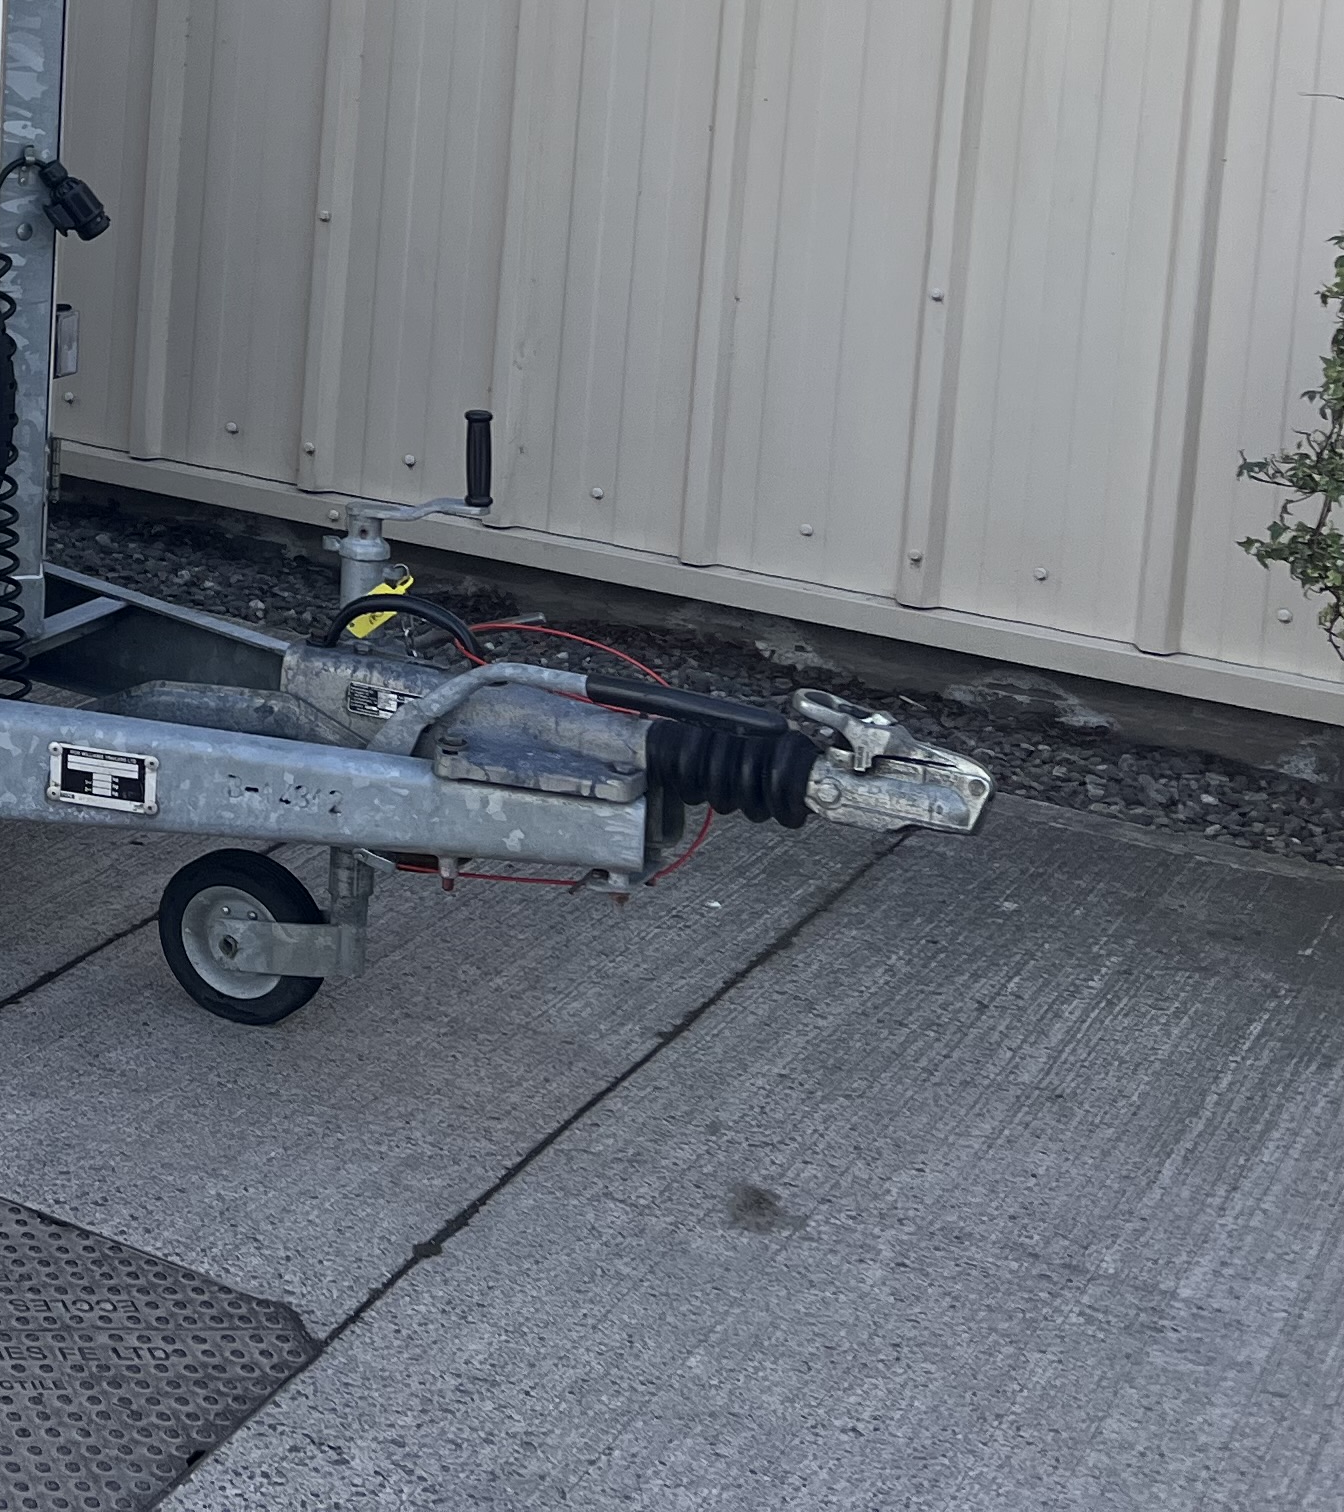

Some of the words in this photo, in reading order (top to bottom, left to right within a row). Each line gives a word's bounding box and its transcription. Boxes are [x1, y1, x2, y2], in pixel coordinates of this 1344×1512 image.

[8, 1298, 141, 1314] ECCLES
[58, 1345, 102, 1362] FE
[111, 1345, 170, 1362] LTD
